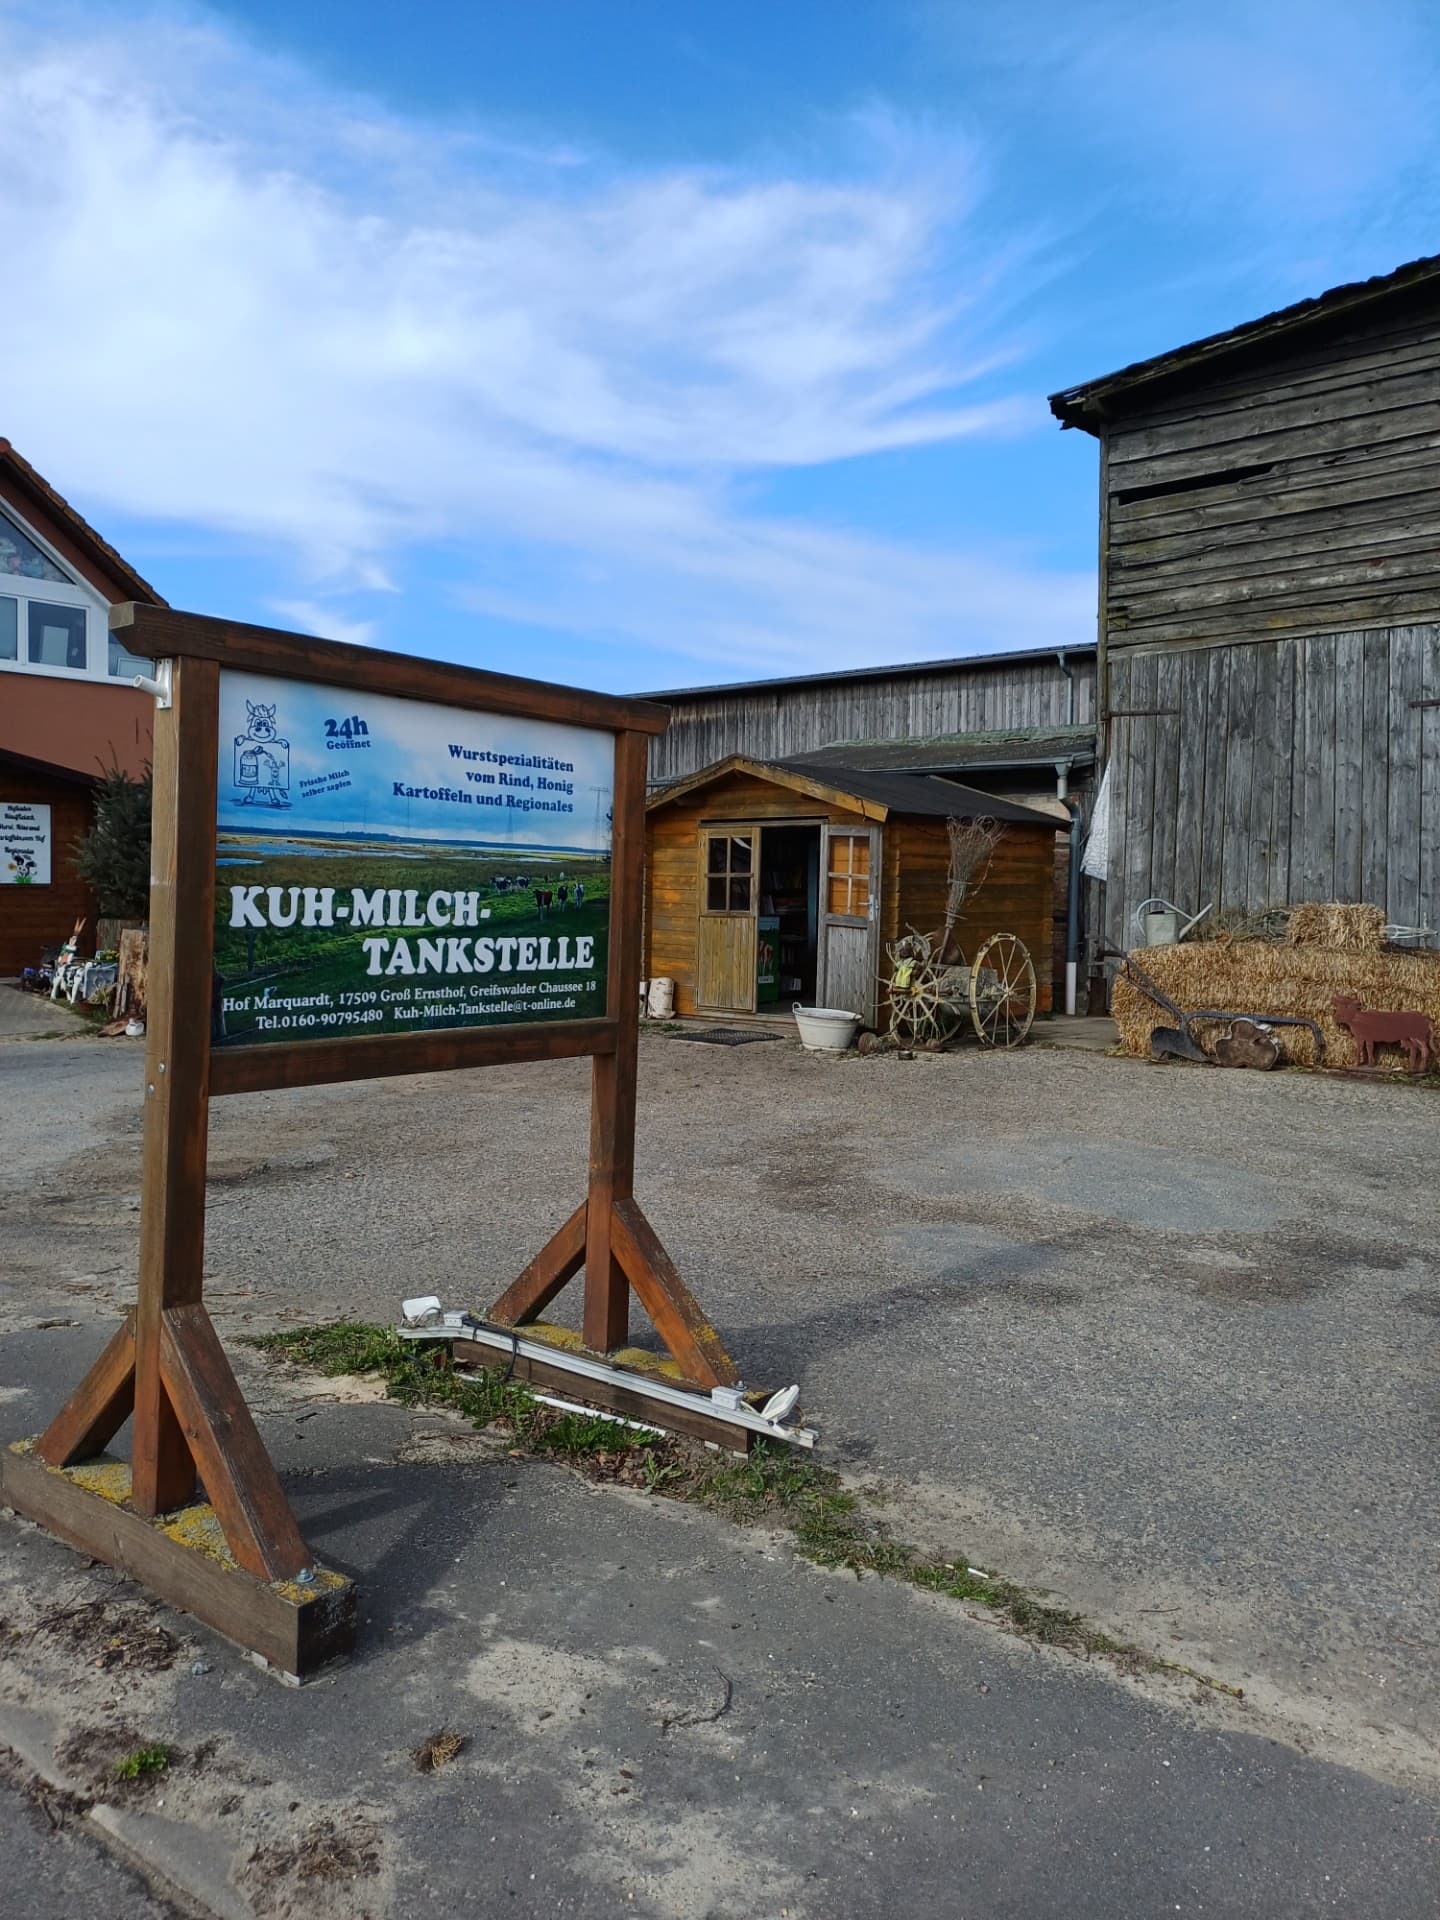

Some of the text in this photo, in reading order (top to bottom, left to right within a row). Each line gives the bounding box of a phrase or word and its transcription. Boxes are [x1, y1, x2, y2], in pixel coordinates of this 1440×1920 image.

[324, 715, 369, 739] 24h
[326, 739, 371, 750] Geöffnet
[448, 744, 574, 772] Wurstspezialitäten
[299, 770, 350, 788] Frische Milch
[301, 780, 352, 798] selber zapfen
[465, 771, 574, 795] vom Rind, Honig
[392, 782, 573, 813] Kartoffeln und Regionales
[229, 885, 491, 928] KUH-MILCH-
[362, 936, 595, 975] TANKSTELLE
[223, 980, 596, 1012] Hof Marquardt, 17509 Groß Ernsthof, Greifswalder Chaussee 18
[255, 997, 576, 1030] Tel.0160-90795480 Kuh-Milch-Tankstelle@t-online.de
